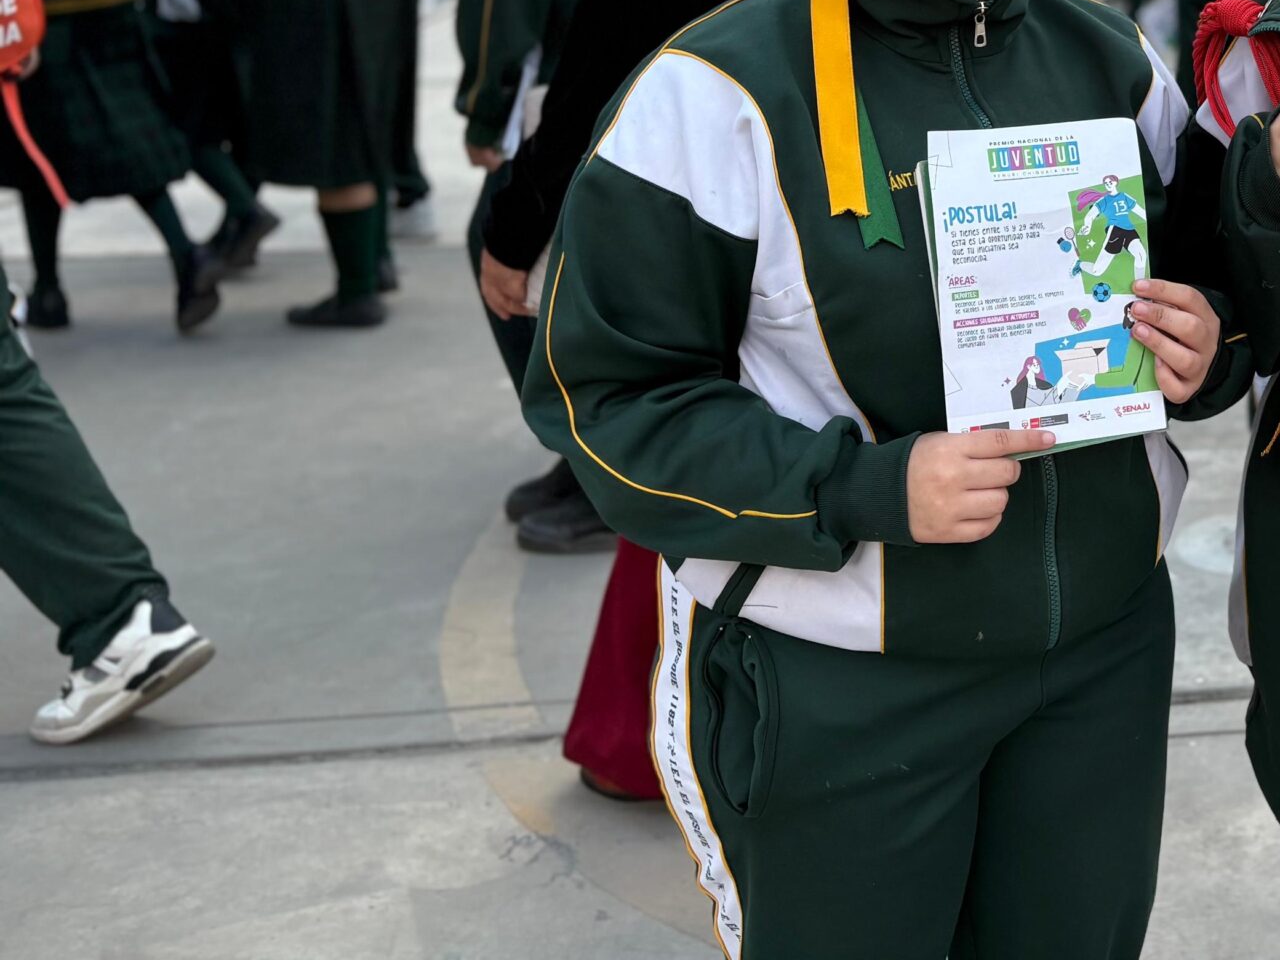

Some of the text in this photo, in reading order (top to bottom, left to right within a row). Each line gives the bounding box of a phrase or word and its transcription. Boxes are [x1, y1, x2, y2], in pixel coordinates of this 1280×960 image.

[991, 145, 1078, 169] JUVENTUD
[1113, 200, 1128, 213] 13
[1003, 225, 1010, 233] 15
[1018, 223, 1027, 231] 29
[1121, 402, 1151, 414] SENAJU
[672, 620, 680, 636] EL
